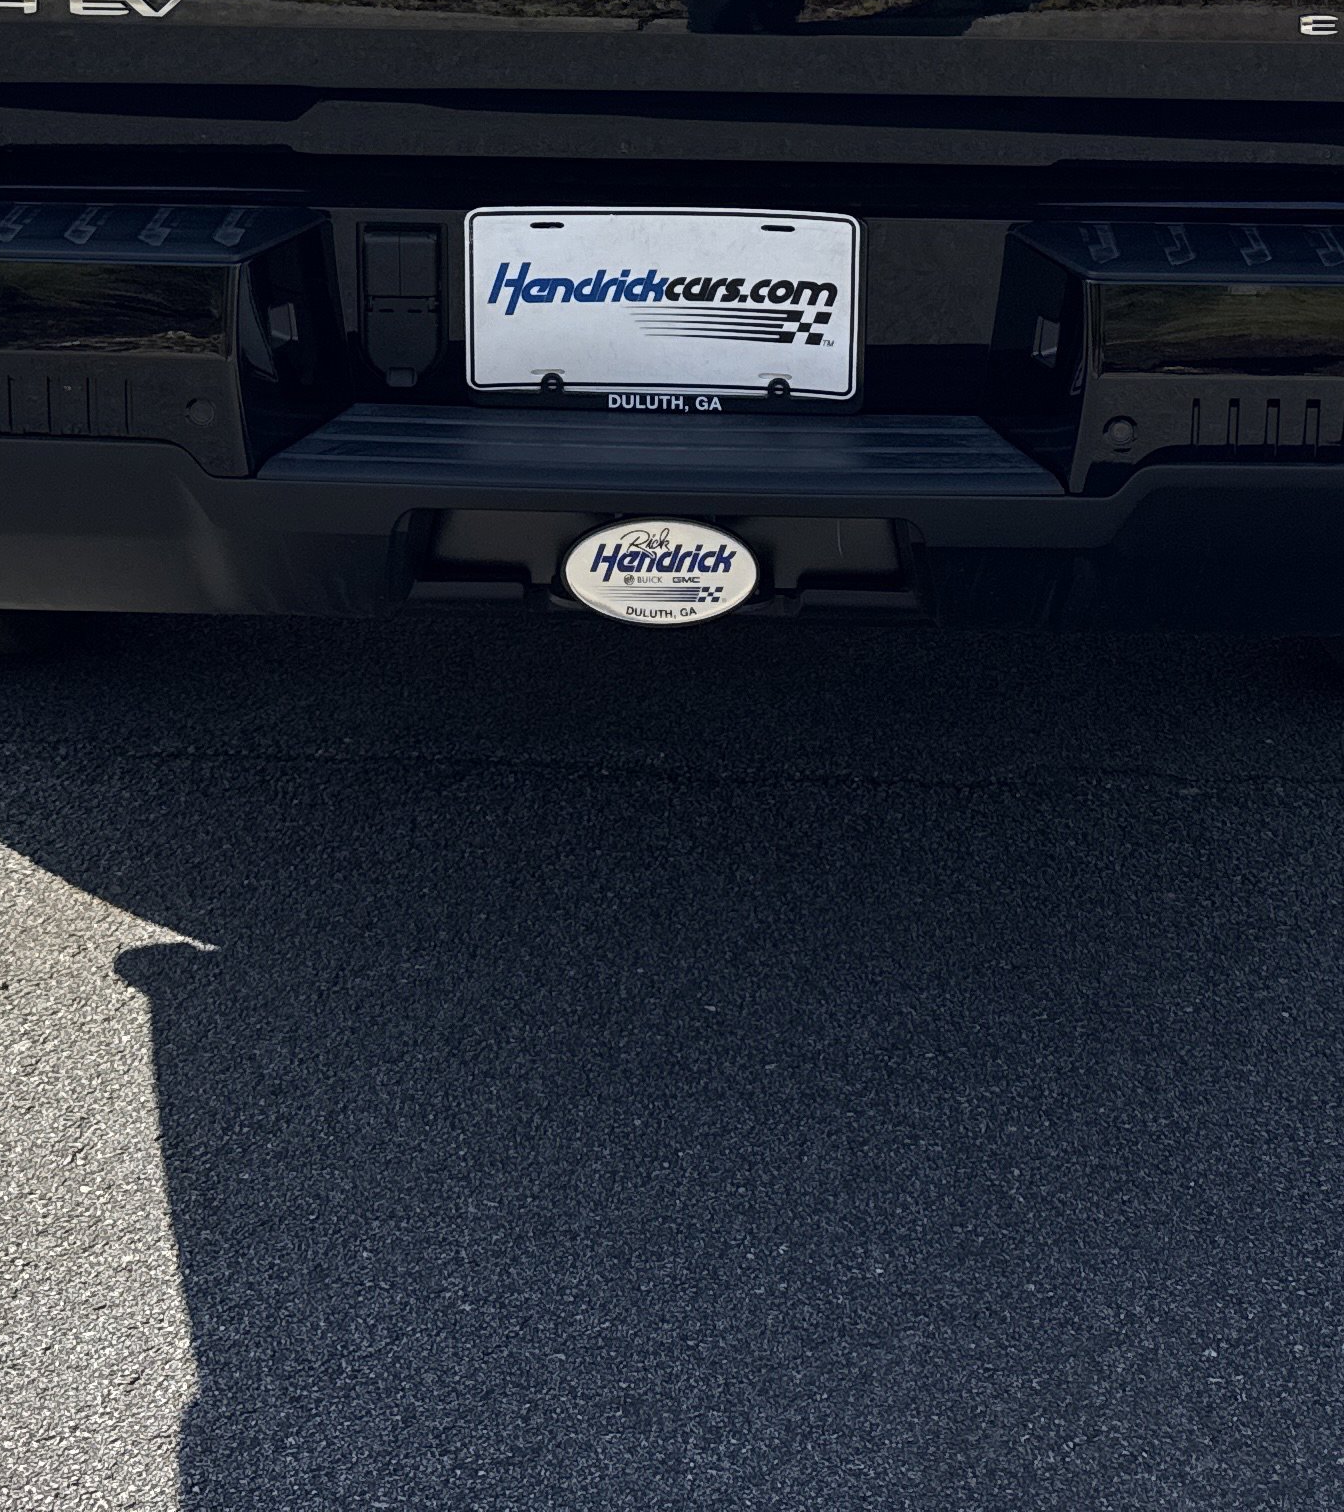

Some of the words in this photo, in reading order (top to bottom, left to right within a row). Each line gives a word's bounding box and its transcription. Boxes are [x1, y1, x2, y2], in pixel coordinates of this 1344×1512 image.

[487, 262, 838, 315] Hendrickcars.com
[608, 394, 689, 412] DULUTH,
[695, 396, 722, 411] GA
[620, 528, 670, 558] Rick
[590, 544, 737, 582] Hendrick
[637, 576, 663, 584] BUICK
[672, 576, 700, 584] GMC
[625, 606, 677, 619] DULUTH,
[679, 607, 697, 617] GA
